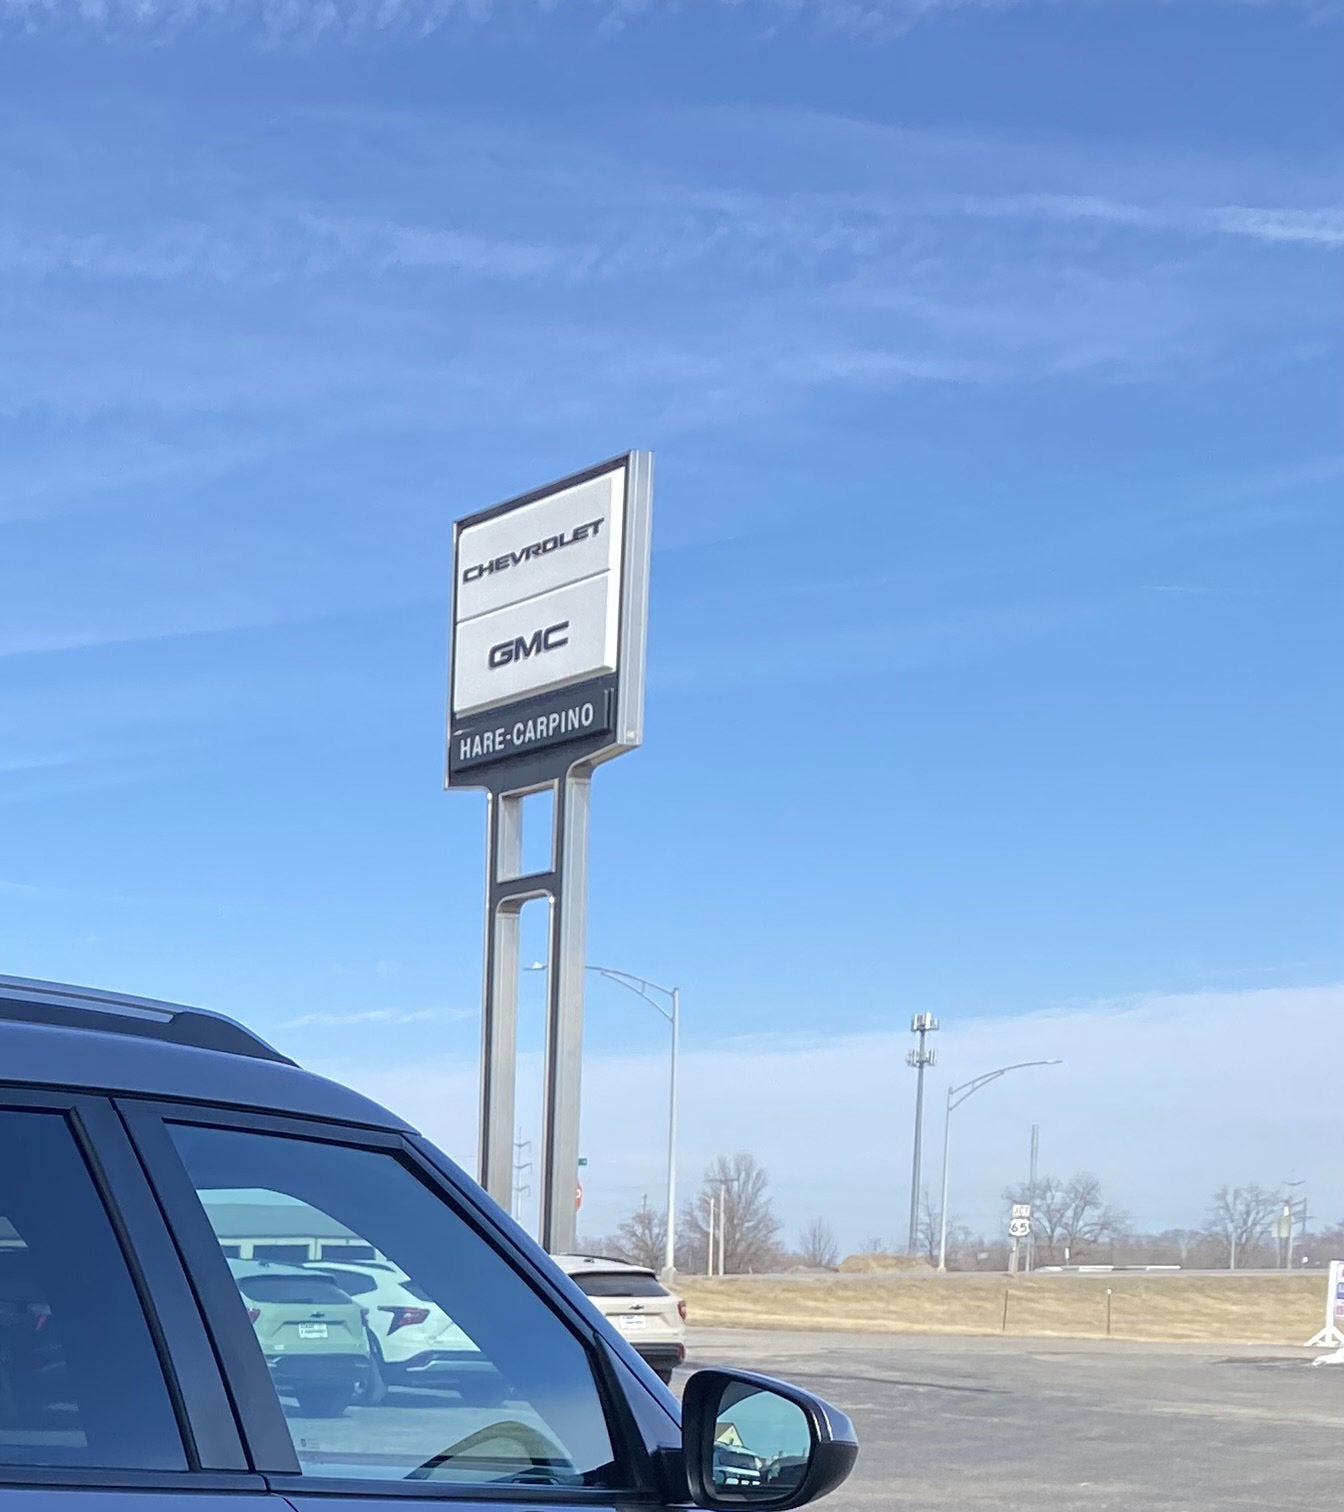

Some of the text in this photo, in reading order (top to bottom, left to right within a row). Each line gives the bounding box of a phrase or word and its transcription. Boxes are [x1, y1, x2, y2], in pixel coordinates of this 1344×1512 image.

[462, 517, 605, 584] CHEVROLET
[487, 620, 570, 670] GMC
[459, 702, 594, 760] HARE-CARPINO
[1011, 1222, 1028, 1233] 65
